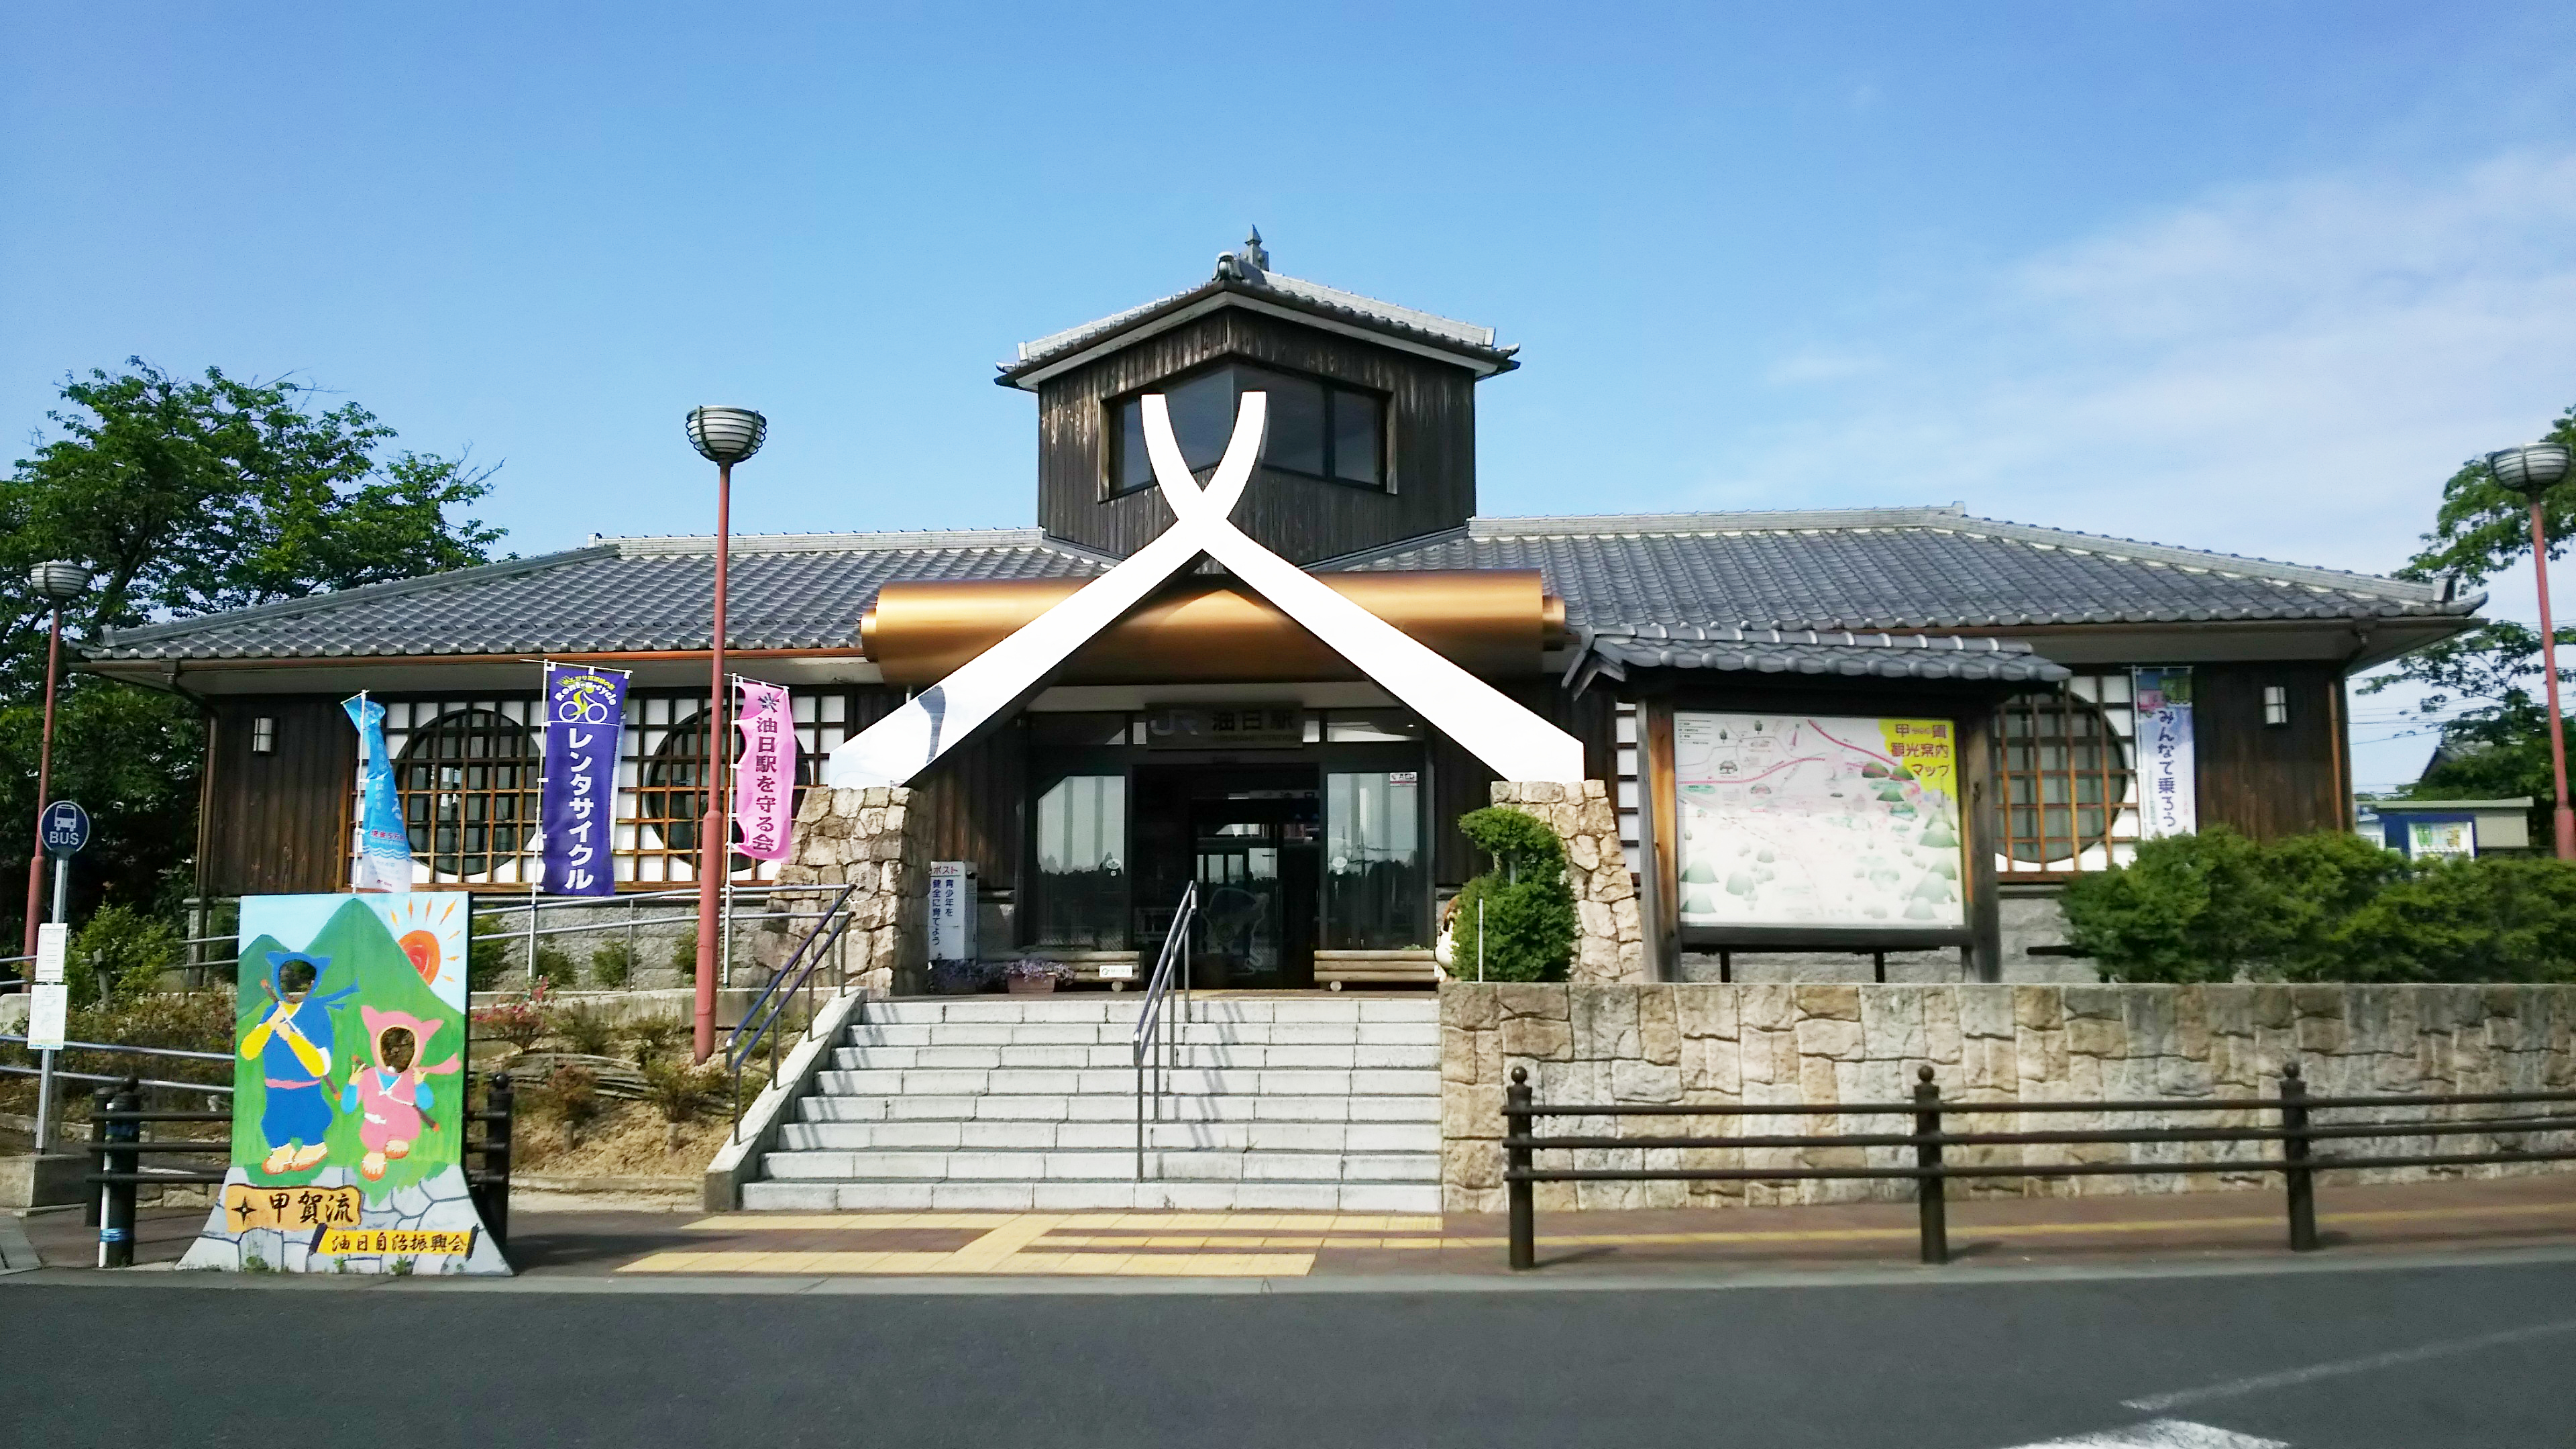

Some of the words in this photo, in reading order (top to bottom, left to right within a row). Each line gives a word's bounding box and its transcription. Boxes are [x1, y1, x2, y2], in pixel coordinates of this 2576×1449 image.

[1150, 709, 1199, 737] JR
[1212, 708, 1295, 732] 油日駅
[1912, 763, 1949, 777] マップ
[2157, 710, 2176, 827] みんなで乗ろう
[753, 716, 778, 853] 油日駅を守る会
[564, 727, 594, 891] レンタサイクル
[50, 831, 79, 845] BUS
[934, 866, 959, 875] ポスト
[932, 879, 942, 945] 健全に育てよう
[945, 879, 954, 917] 青少年を
[269, 1190, 354, 1225] 甲賀流
[331, 1232, 468, 1253] 油日自治振興会
